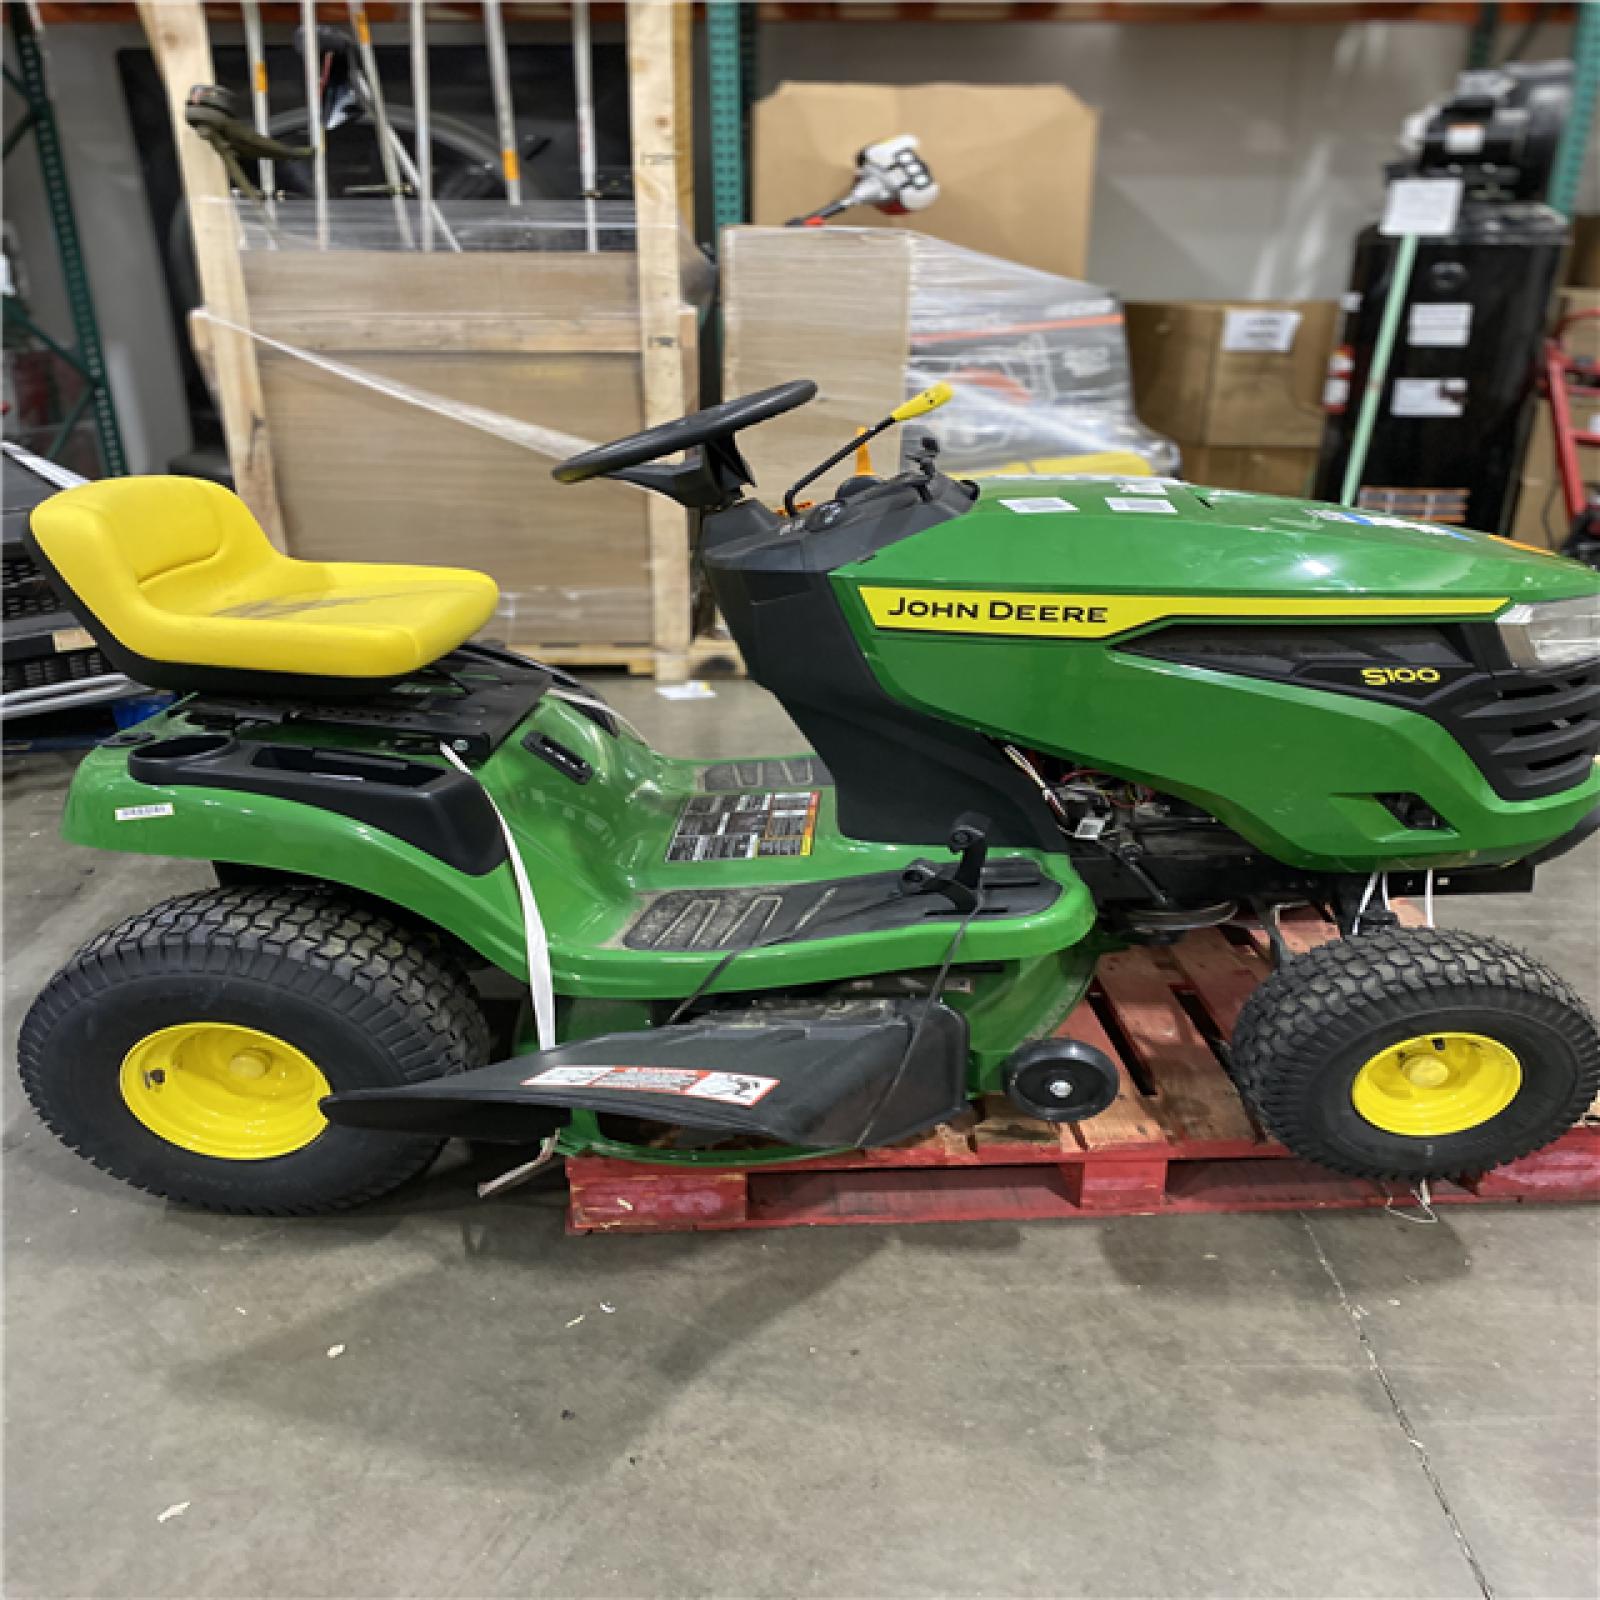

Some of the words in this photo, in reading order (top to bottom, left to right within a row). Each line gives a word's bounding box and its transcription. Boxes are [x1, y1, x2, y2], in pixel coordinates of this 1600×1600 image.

[888, 597, 979, 618] JOHN
[989, 600, 1109, 623] DEERE
[1361, 667, 1441, 686] S100
